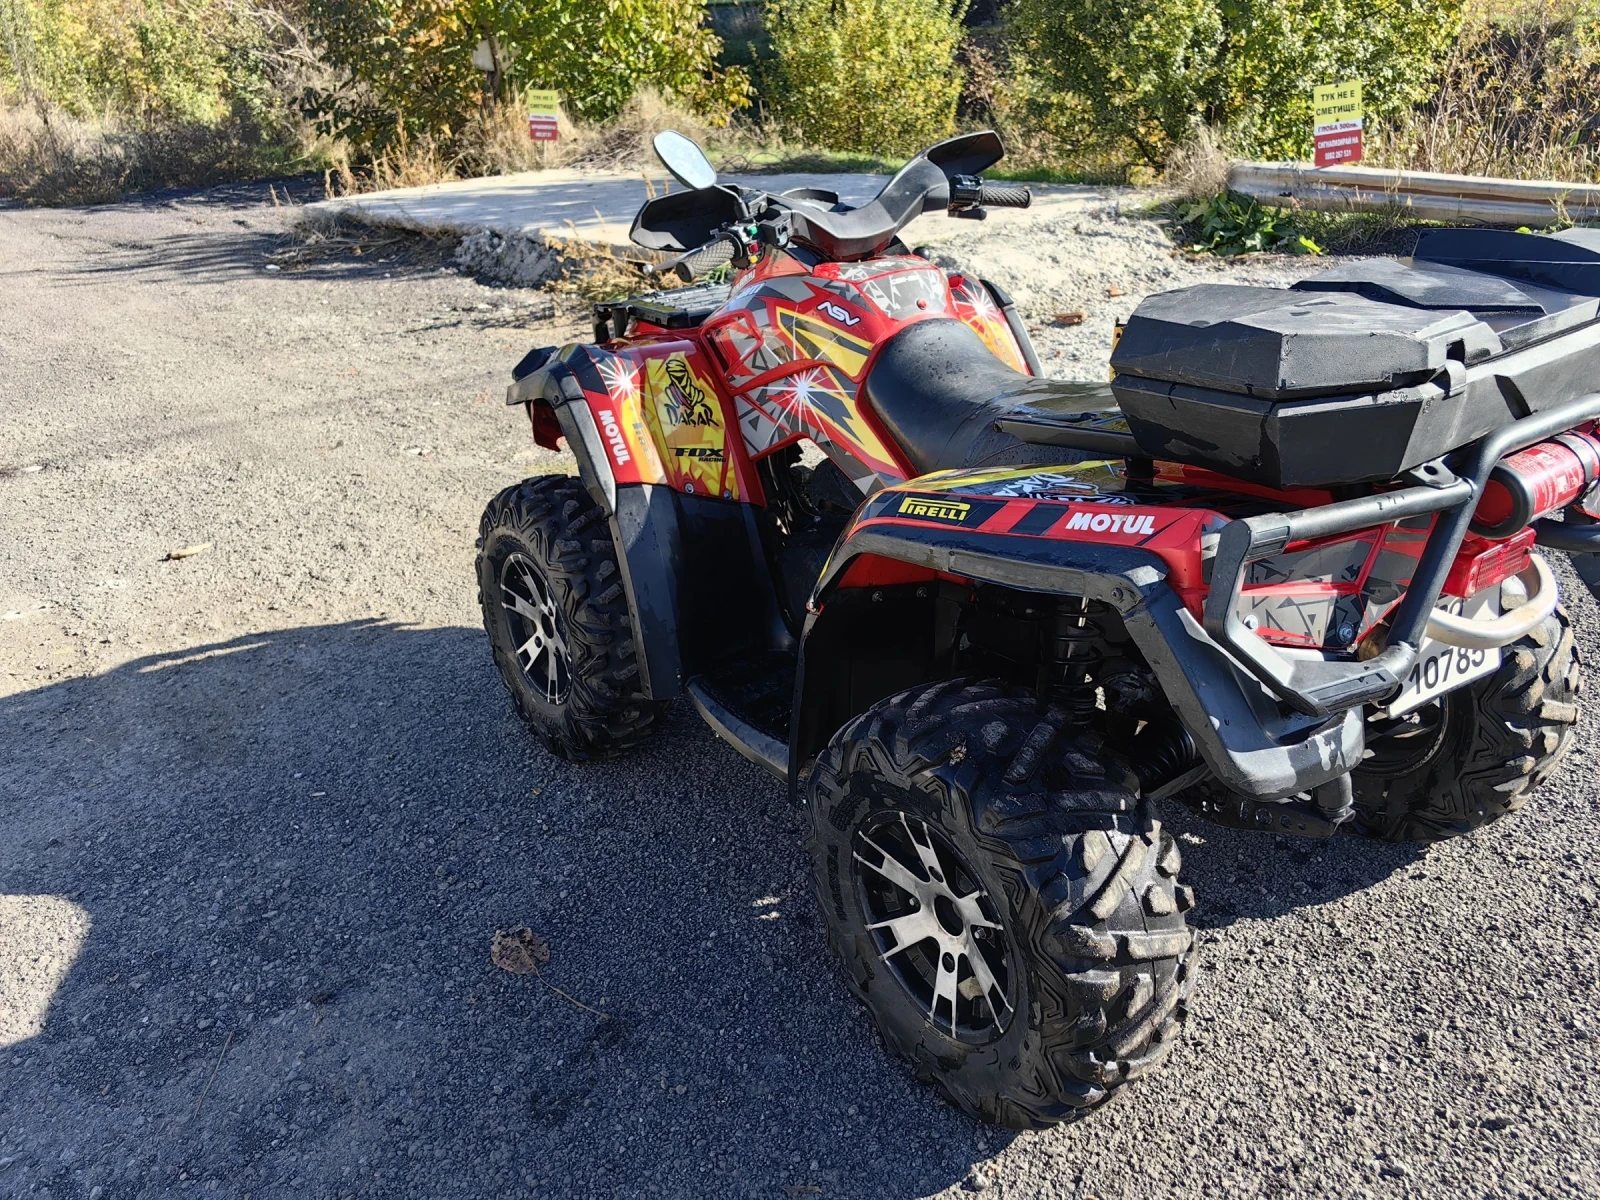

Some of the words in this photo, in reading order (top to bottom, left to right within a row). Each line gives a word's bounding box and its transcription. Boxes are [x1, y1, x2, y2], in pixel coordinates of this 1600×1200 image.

[1321, 92, 1335, 101] ТУК
[1337, 90, 1348, 100] НЕ
[1350, 90, 1355, 98] Е
[1316, 103, 1356, 116] СМЕТИЩЕ
[664, 403, 719, 427] DAKAR
[598, 409, 631, 466] MOTUL
[674, 447, 724, 457] FOX
[898, 497, 971, 521] PIRELLI
[1066, 512, 1156, 535] MOTUL
